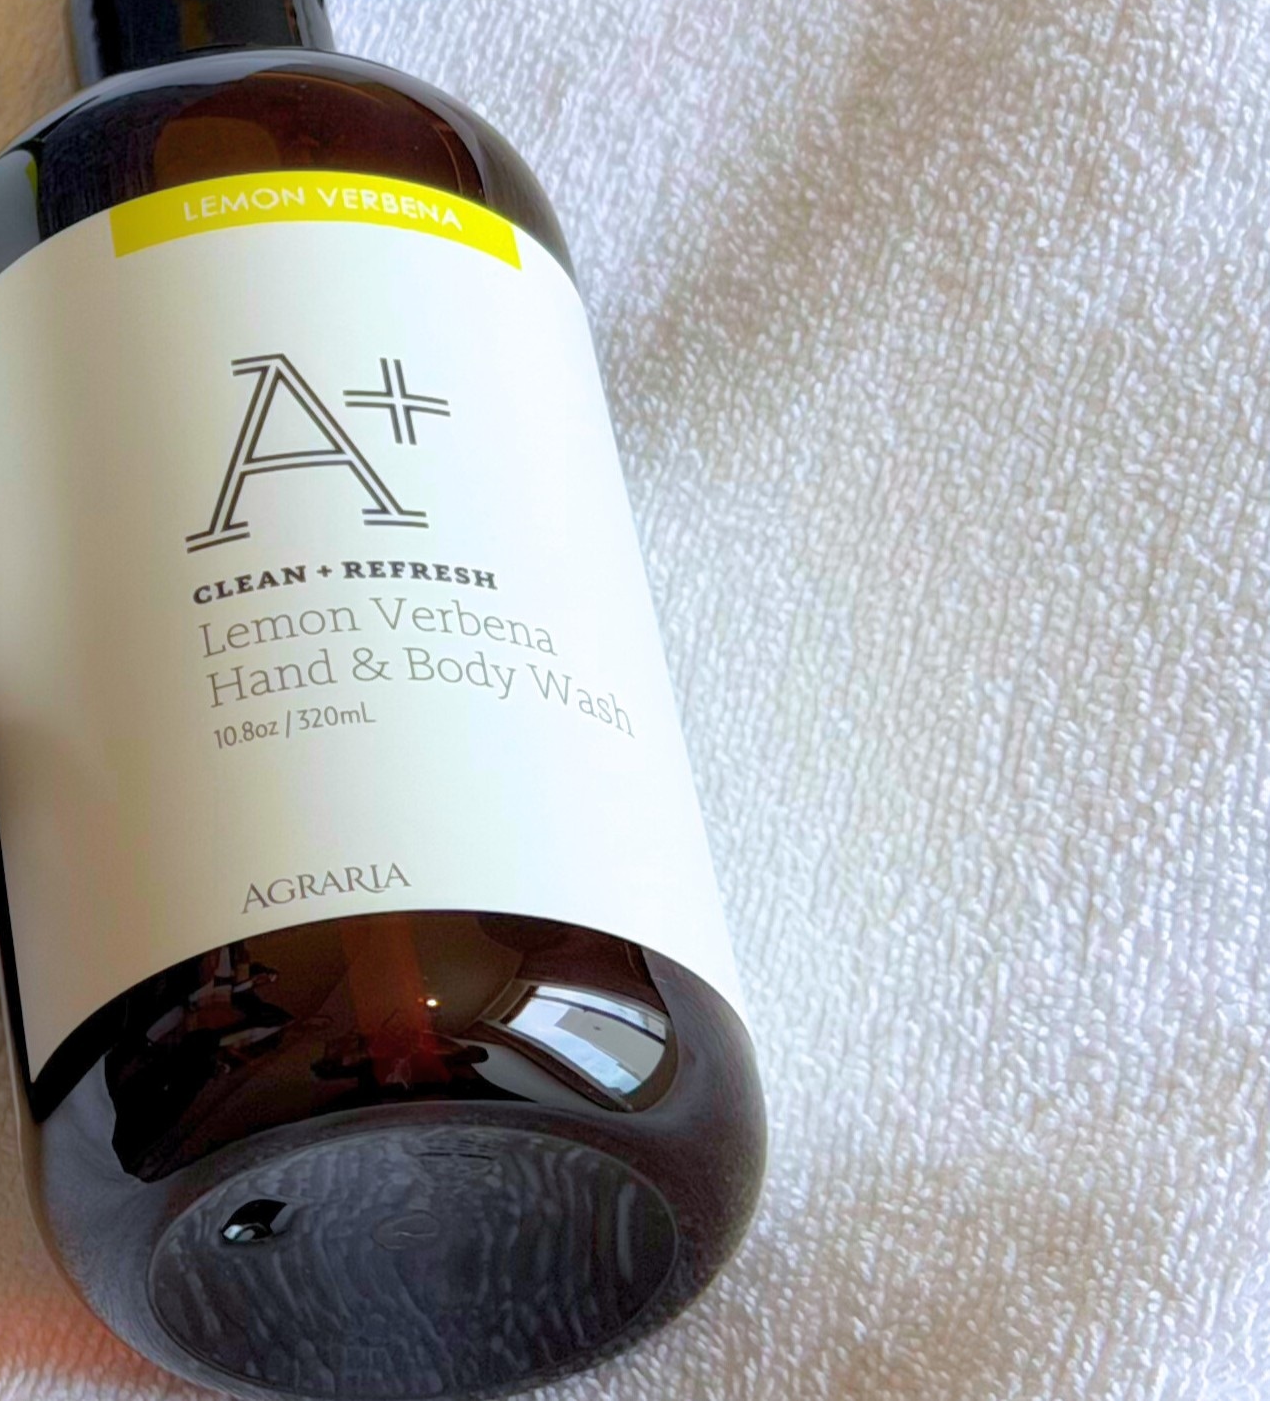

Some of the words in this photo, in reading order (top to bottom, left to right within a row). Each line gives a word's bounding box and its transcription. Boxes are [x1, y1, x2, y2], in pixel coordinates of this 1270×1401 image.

[183, 186, 306, 222] LEMON
[316, 187, 463, 231] VERBENA
[192, 564, 307, 606] CLEAN
[340, 559, 498, 591] REFRESH
[198, 607, 363, 659] Lemon
[368, 596, 558, 657] Verbena
[206, 648, 338, 708] Hand
[350, 647, 393, 682] &
[404, 647, 518, 700] Body
[523, 662, 635, 739] Wash
[213, 720, 280, 749] 10.8oz
[296, 701, 377, 730] 320mL
[241, 862, 412, 914] AGRARIA
